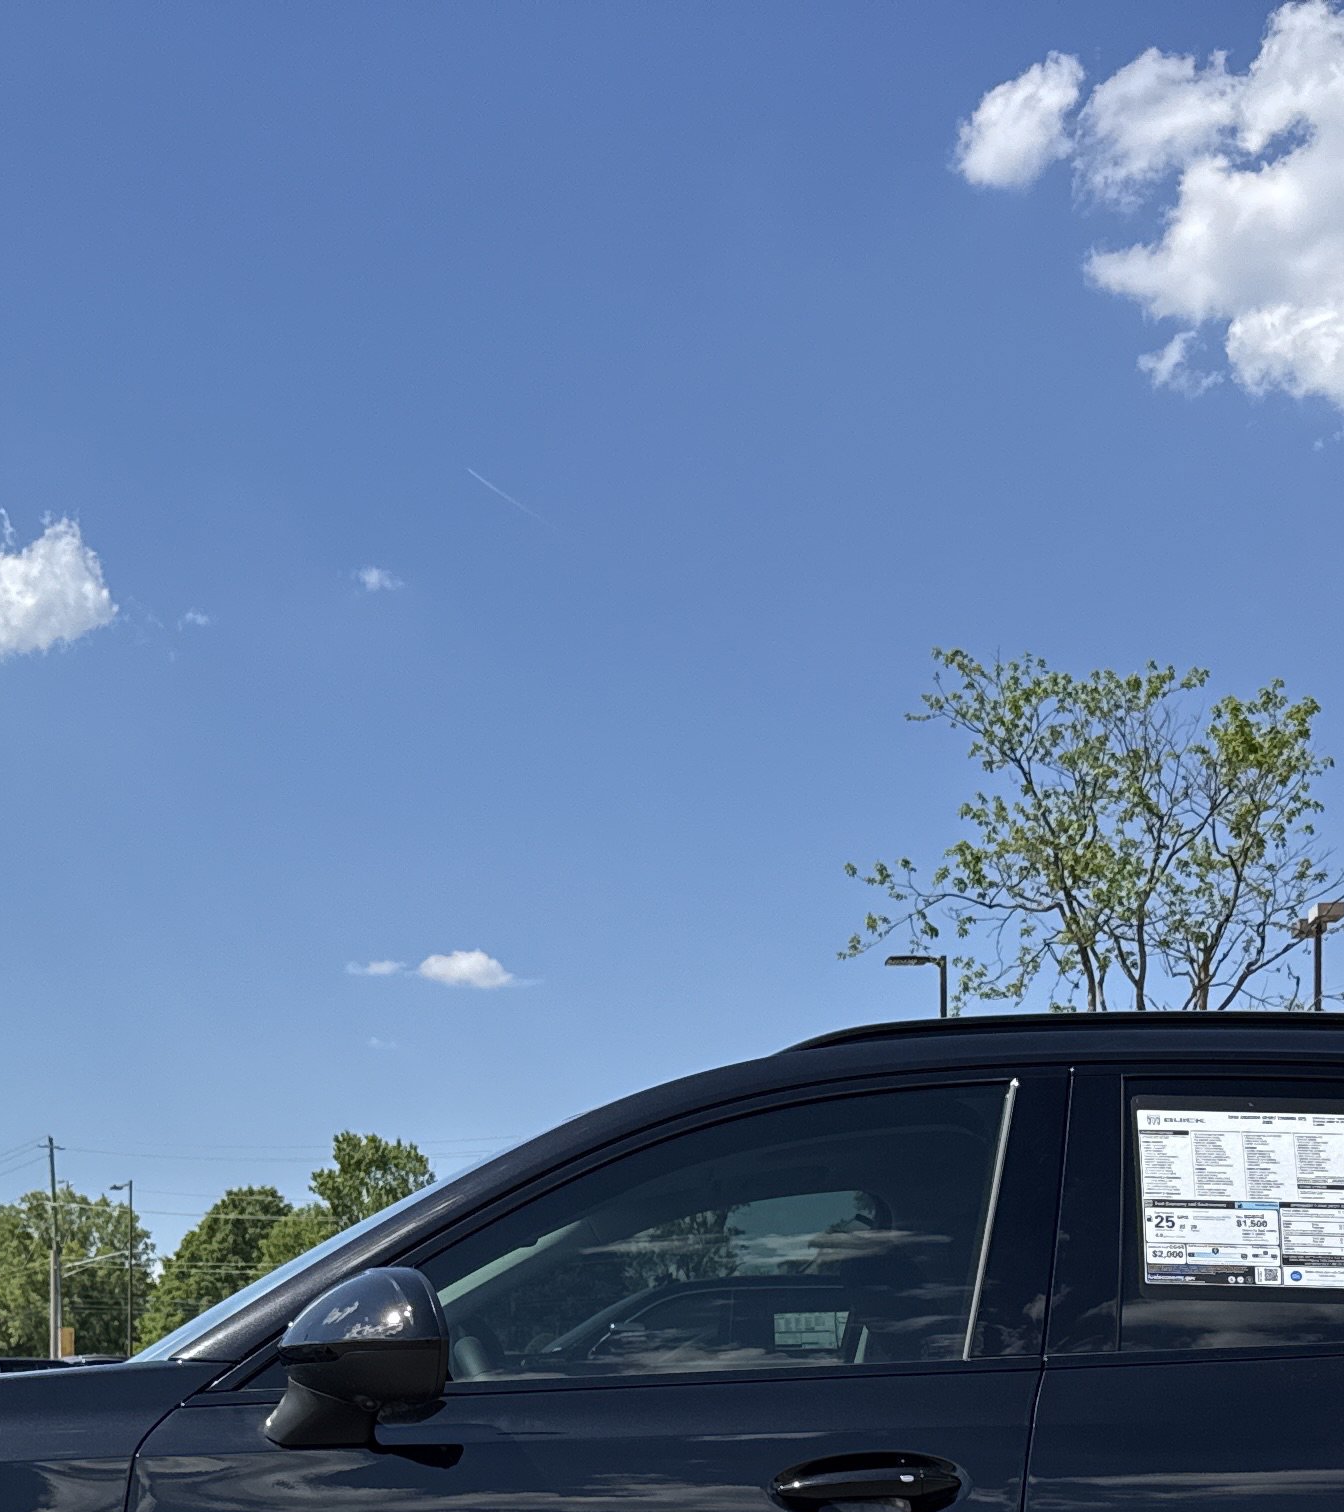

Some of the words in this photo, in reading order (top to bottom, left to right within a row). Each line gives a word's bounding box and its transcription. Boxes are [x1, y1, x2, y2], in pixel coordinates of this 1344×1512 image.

[1154, 1215, 1176, 1229] 25
[1236, 1219, 1268, 1228] $1,500
[1152, 1250, 1184, 1259] $2,000
